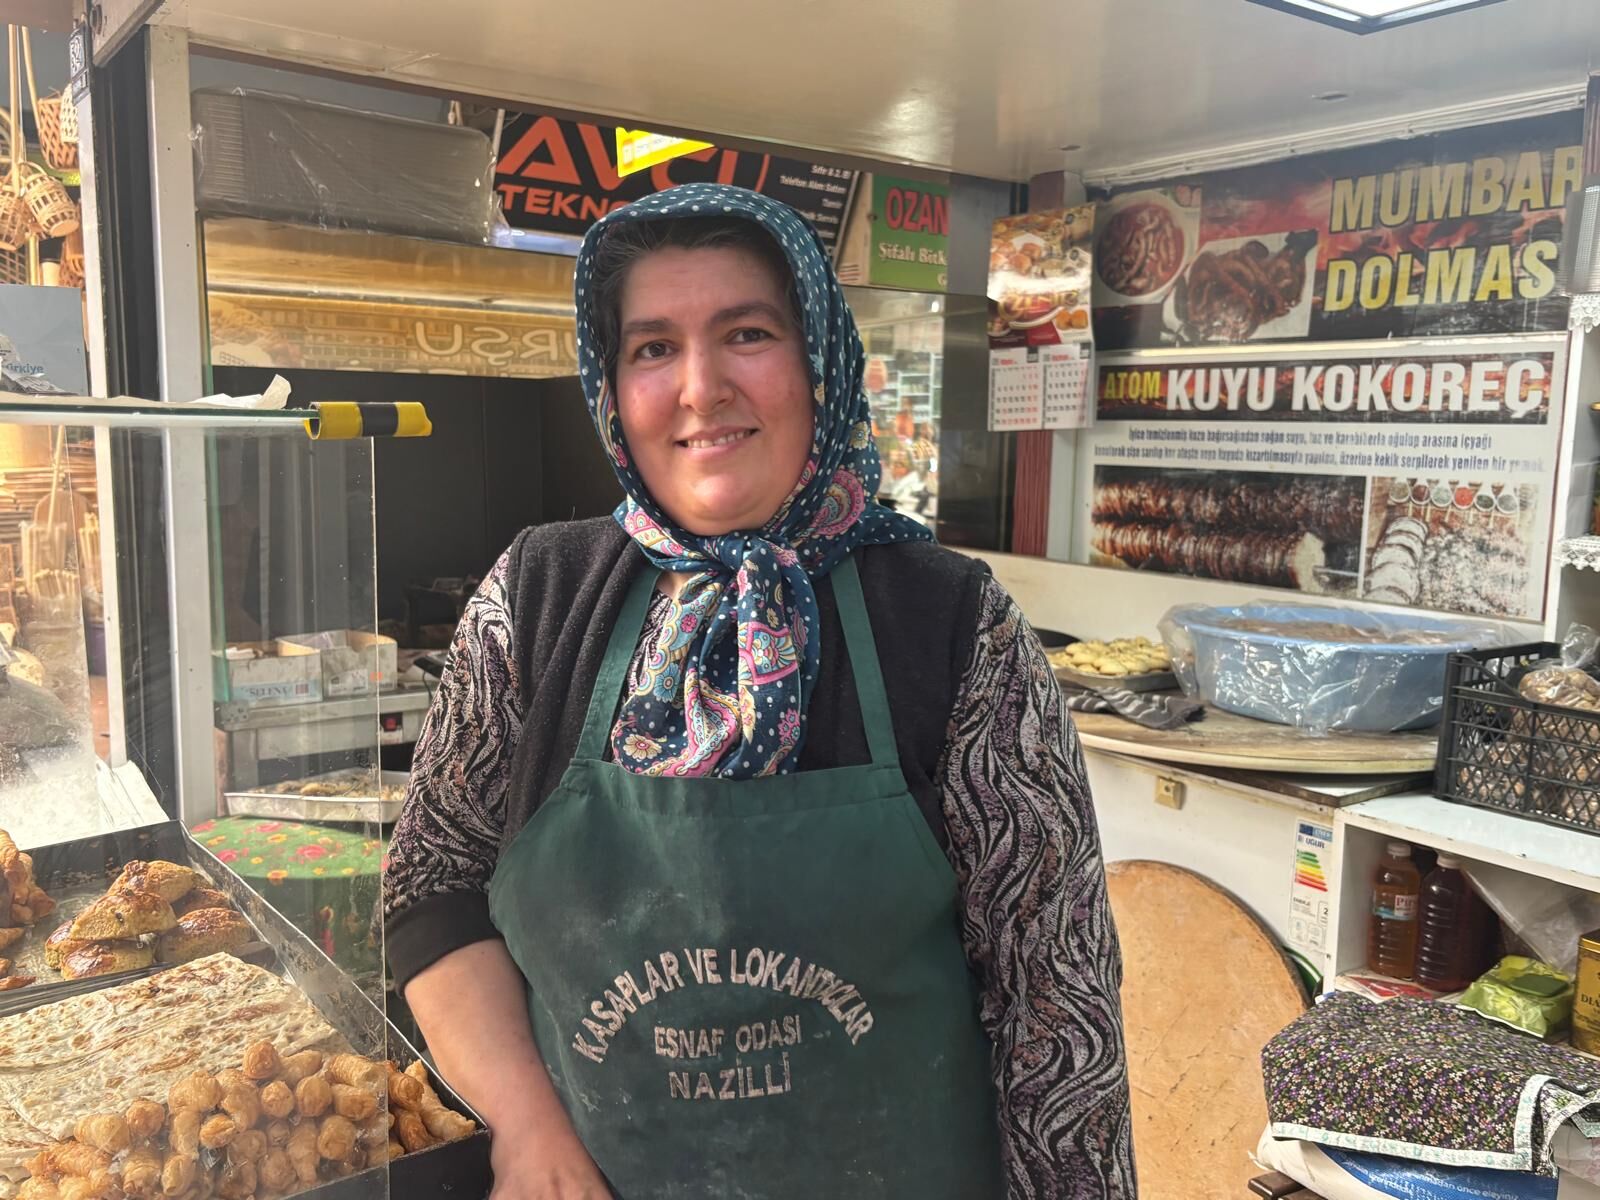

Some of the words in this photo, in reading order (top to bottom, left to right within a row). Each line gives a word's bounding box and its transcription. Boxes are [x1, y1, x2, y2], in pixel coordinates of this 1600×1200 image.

[886, 187, 948, 236] OZAN
[1330, 145, 1583, 233] MUMBAR
[1324, 240, 1558, 312] DOLMAS
[1104, 369, 1161, 399] ATOM
[1166, 366, 1276, 412] KUYU
[1291, 359, 1545, 419] KOKOREÇ
[1323, 433, 1334, 445] ve
[1422, 433, 1458, 448] arasına
[572, 950, 685, 1063] KASAPLAR
[684, 948, 722, 984] VE
[655, 1025, 724, 1059] ESNAF
[735, 1015, 801, 1052] ODASI
[669, 1051, 791, 1100] NAZİLLİ
